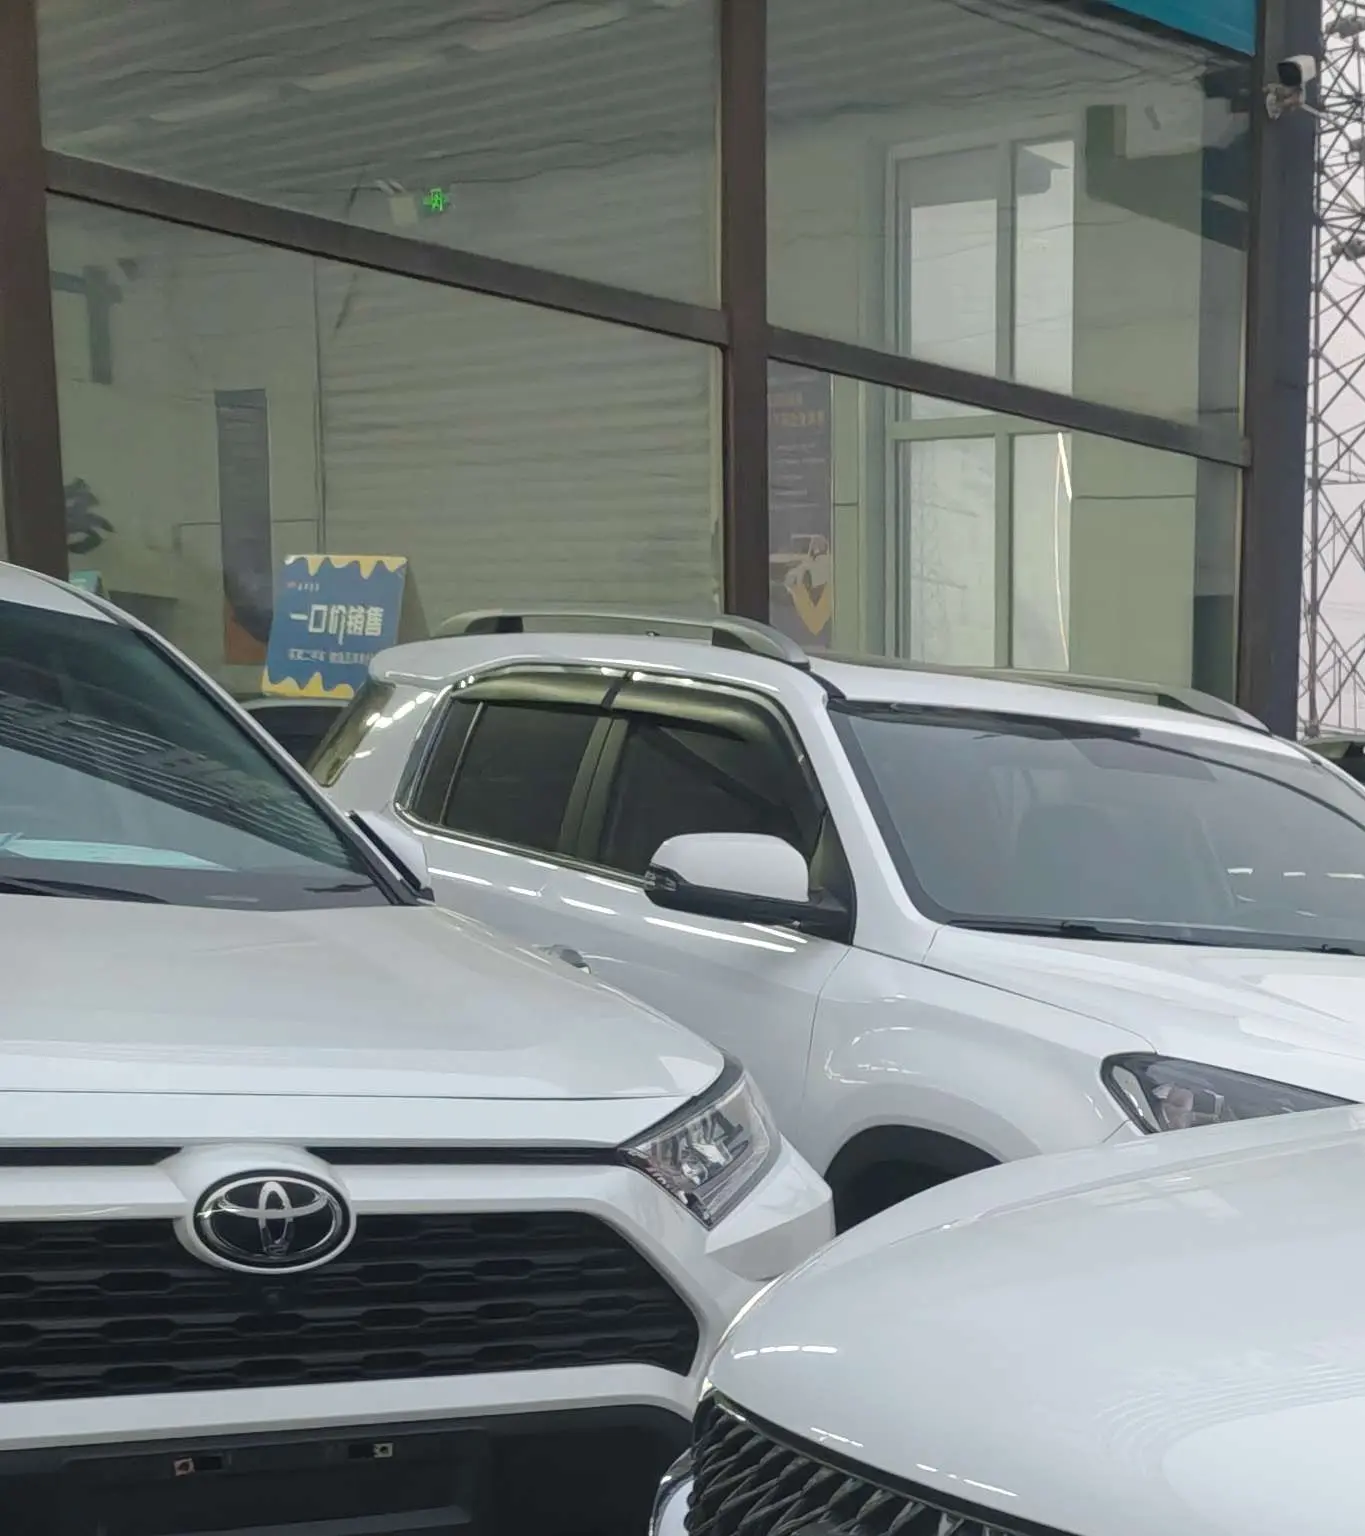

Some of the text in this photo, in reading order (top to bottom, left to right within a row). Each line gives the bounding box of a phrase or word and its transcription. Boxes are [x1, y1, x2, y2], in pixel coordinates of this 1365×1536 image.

[289, 603, 384, 646] 一口价销售
